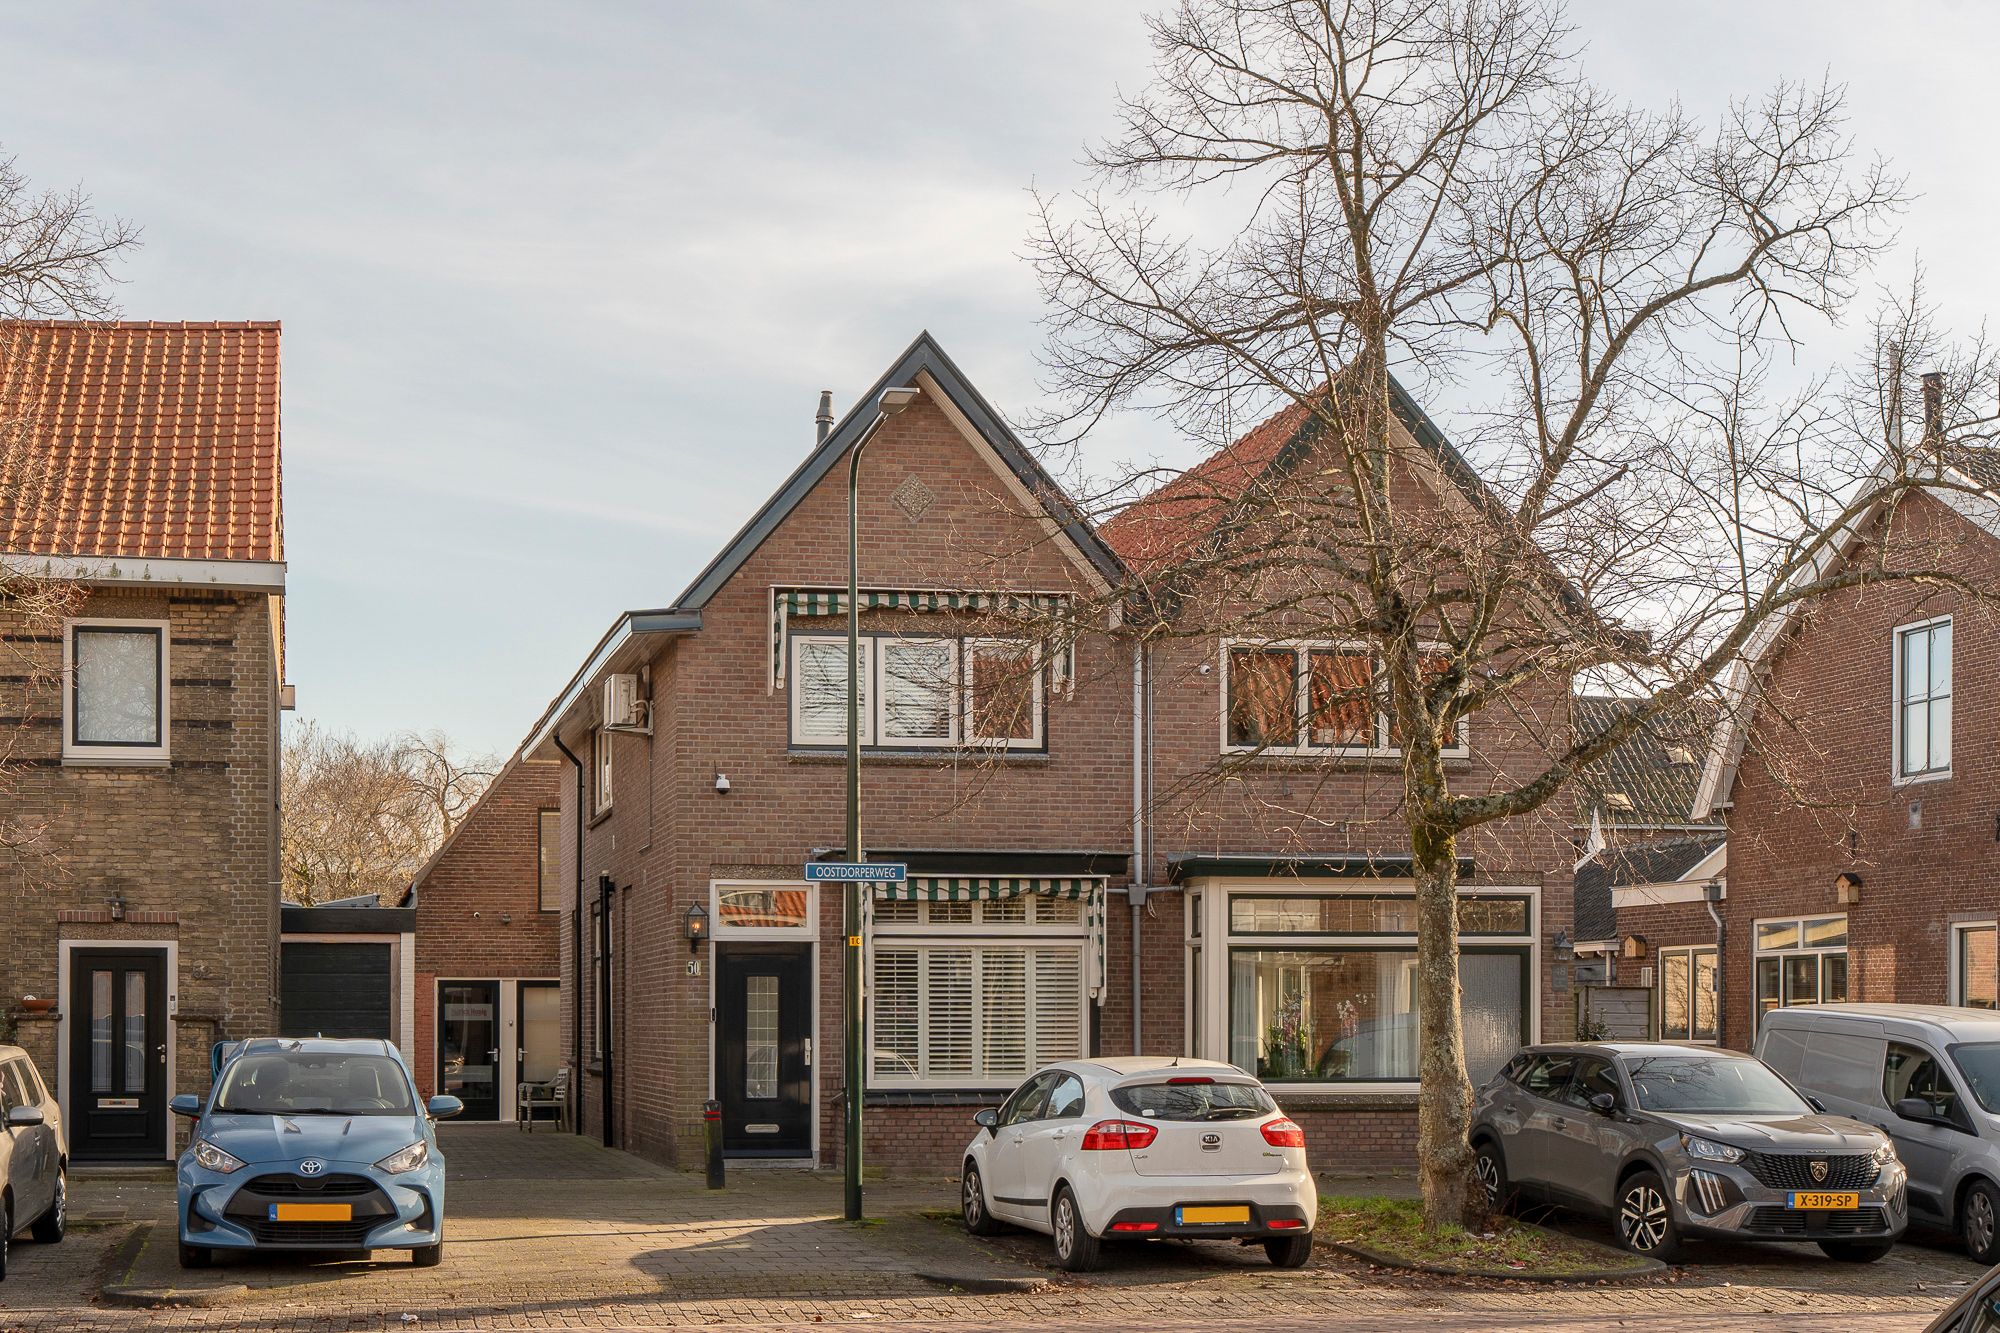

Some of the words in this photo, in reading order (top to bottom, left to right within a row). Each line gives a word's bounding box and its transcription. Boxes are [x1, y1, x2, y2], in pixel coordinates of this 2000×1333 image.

[815, 866, 896, 878] OOSTDORPERWEG
[687, 961, 699, 974] 50
[1800, 1195, 1852, 1206] X-319-SP
